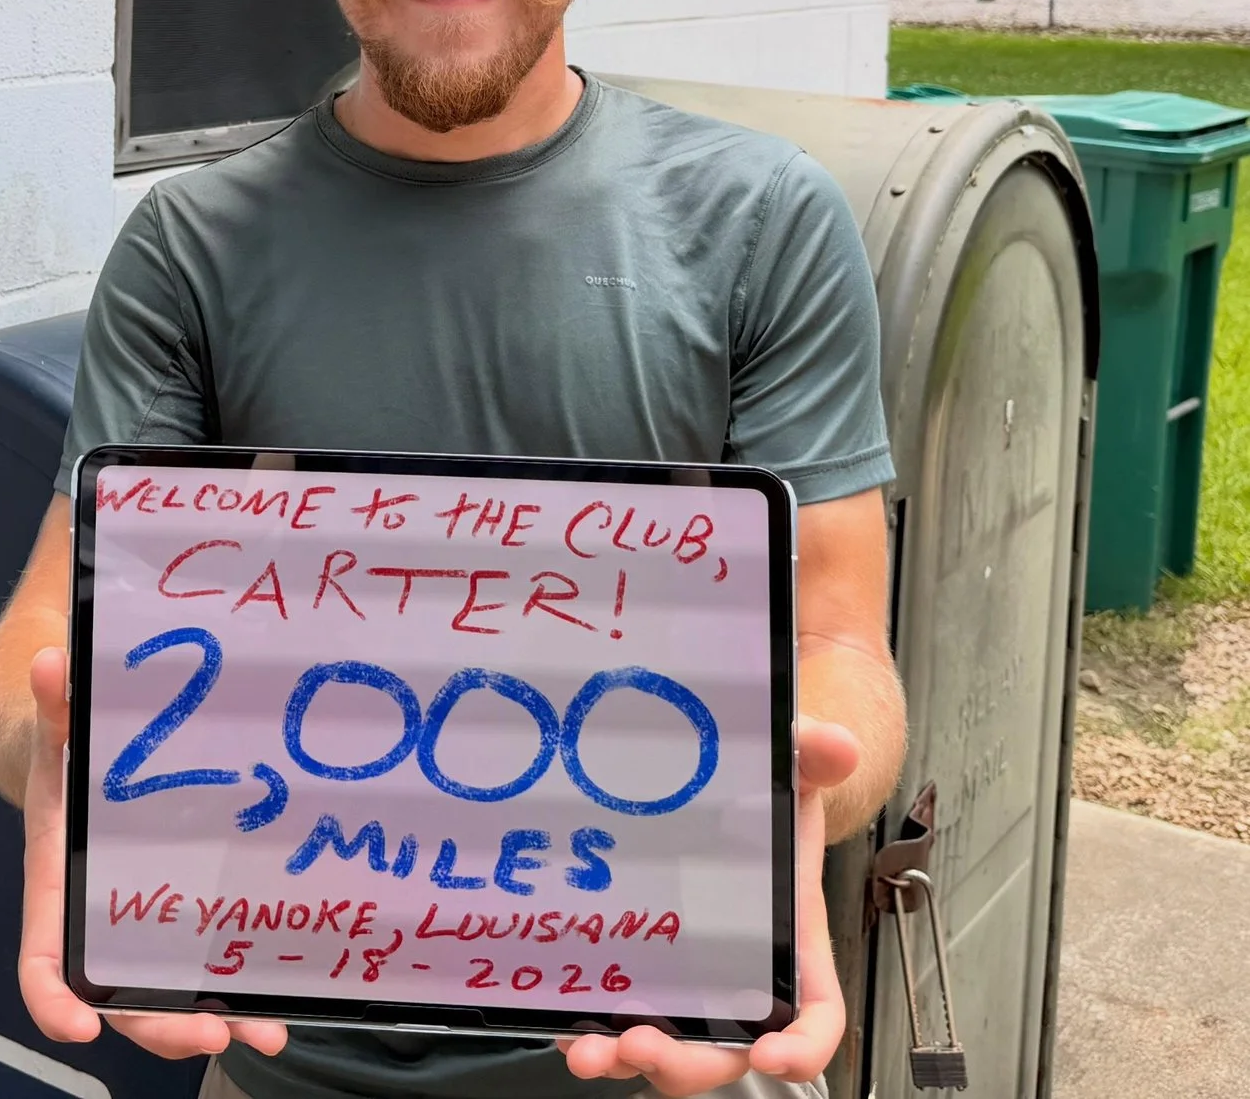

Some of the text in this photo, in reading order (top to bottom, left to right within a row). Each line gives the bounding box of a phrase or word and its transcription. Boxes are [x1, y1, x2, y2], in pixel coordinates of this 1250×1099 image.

[96, 477, 337, 531] WELCOME
[564, 500, 729, 584] CLUB,
[157, 538, 630, 641] CARTER!
[102, 626, 721, 833] 2,000
[285, 812, 619, 897] MILES
[108, 883, 682, 956] WEYANOKE, LOUISIANA
